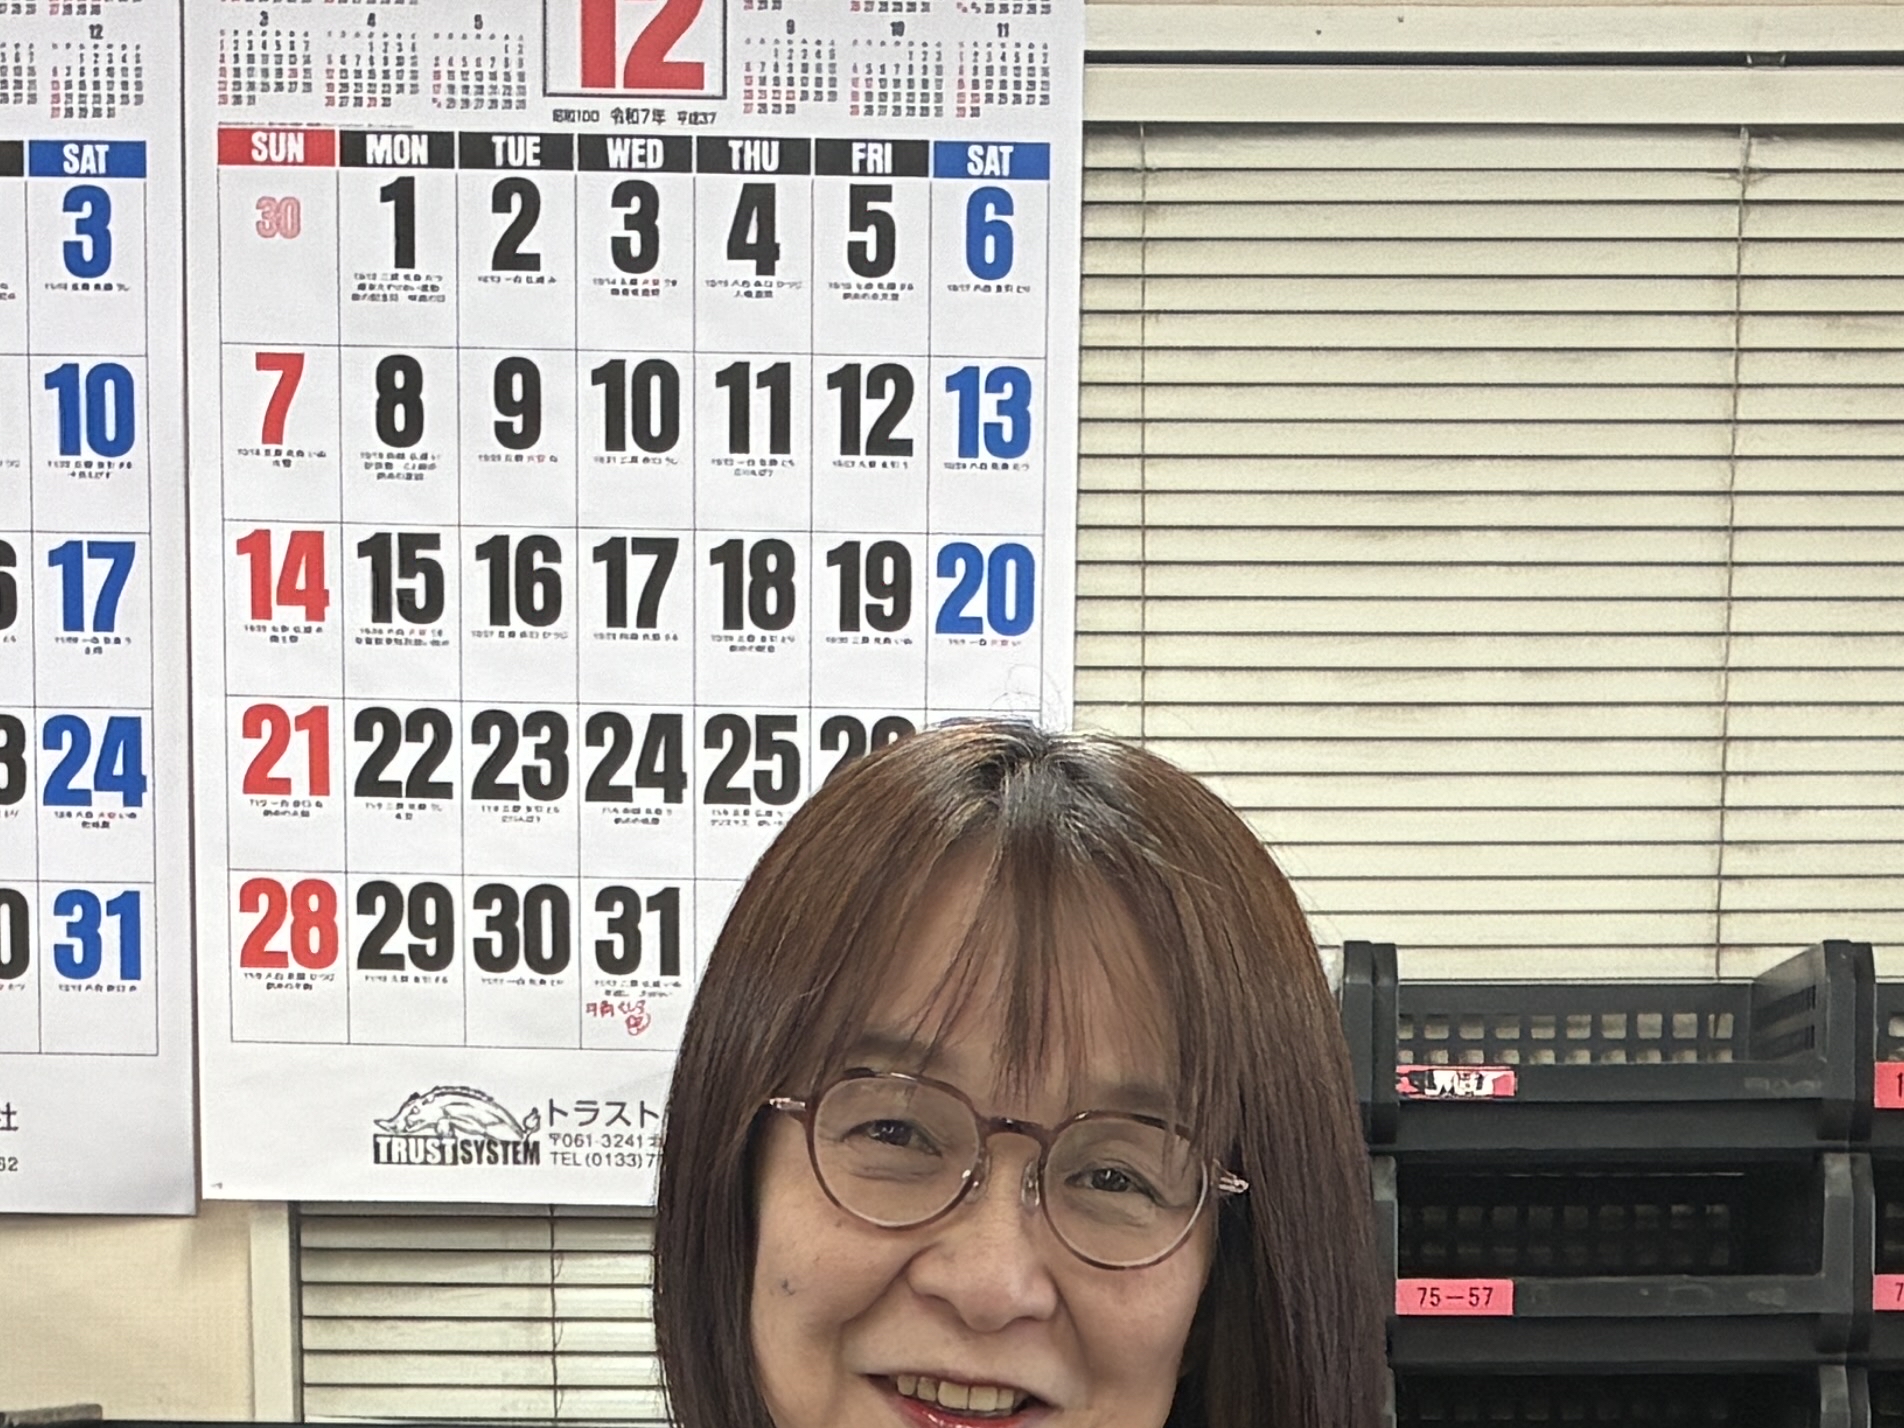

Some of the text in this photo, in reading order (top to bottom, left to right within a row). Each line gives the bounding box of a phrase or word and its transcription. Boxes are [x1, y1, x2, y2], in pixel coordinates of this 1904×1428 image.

[580, 0, 705, 90] 12
[63, 144, 109, 174] SAT
[252, 132, 1013, 176] SUN MON TUE WED THU FRI SAT
[610, 108, 665, 126] 令和7年
[63, 185, 111, 278] 3
[380, 176, 415, 269] 1
[492, 177, 540, 271] 2
[611, 180, 659, 274] 3
[727, 183, 780, 276] 4
[848, 184, 895, 278] 5
[966, 186, 1013, 280] 6
[45, 363, 134, 457] 10
[256, 352, 1031, 459] 7 8 9 10 11 12 13
[48, 540, 135, 632] 17
[237, 529, 1035, 636] 14 15 16 17 18 19 20
[43, 715, 147, 807] 24
[243, 704, 800, 805] 21 22 23 24 25
[54, 889, 141, 980] 31
[240, 878, 680, 976] 28 29 30 31
[376, 1134, 541, 1165] TRUST SYSTEM
[549, 1098, 660, 1128] トラスト
[1416, 1285, 1494, 1309] 75-57
